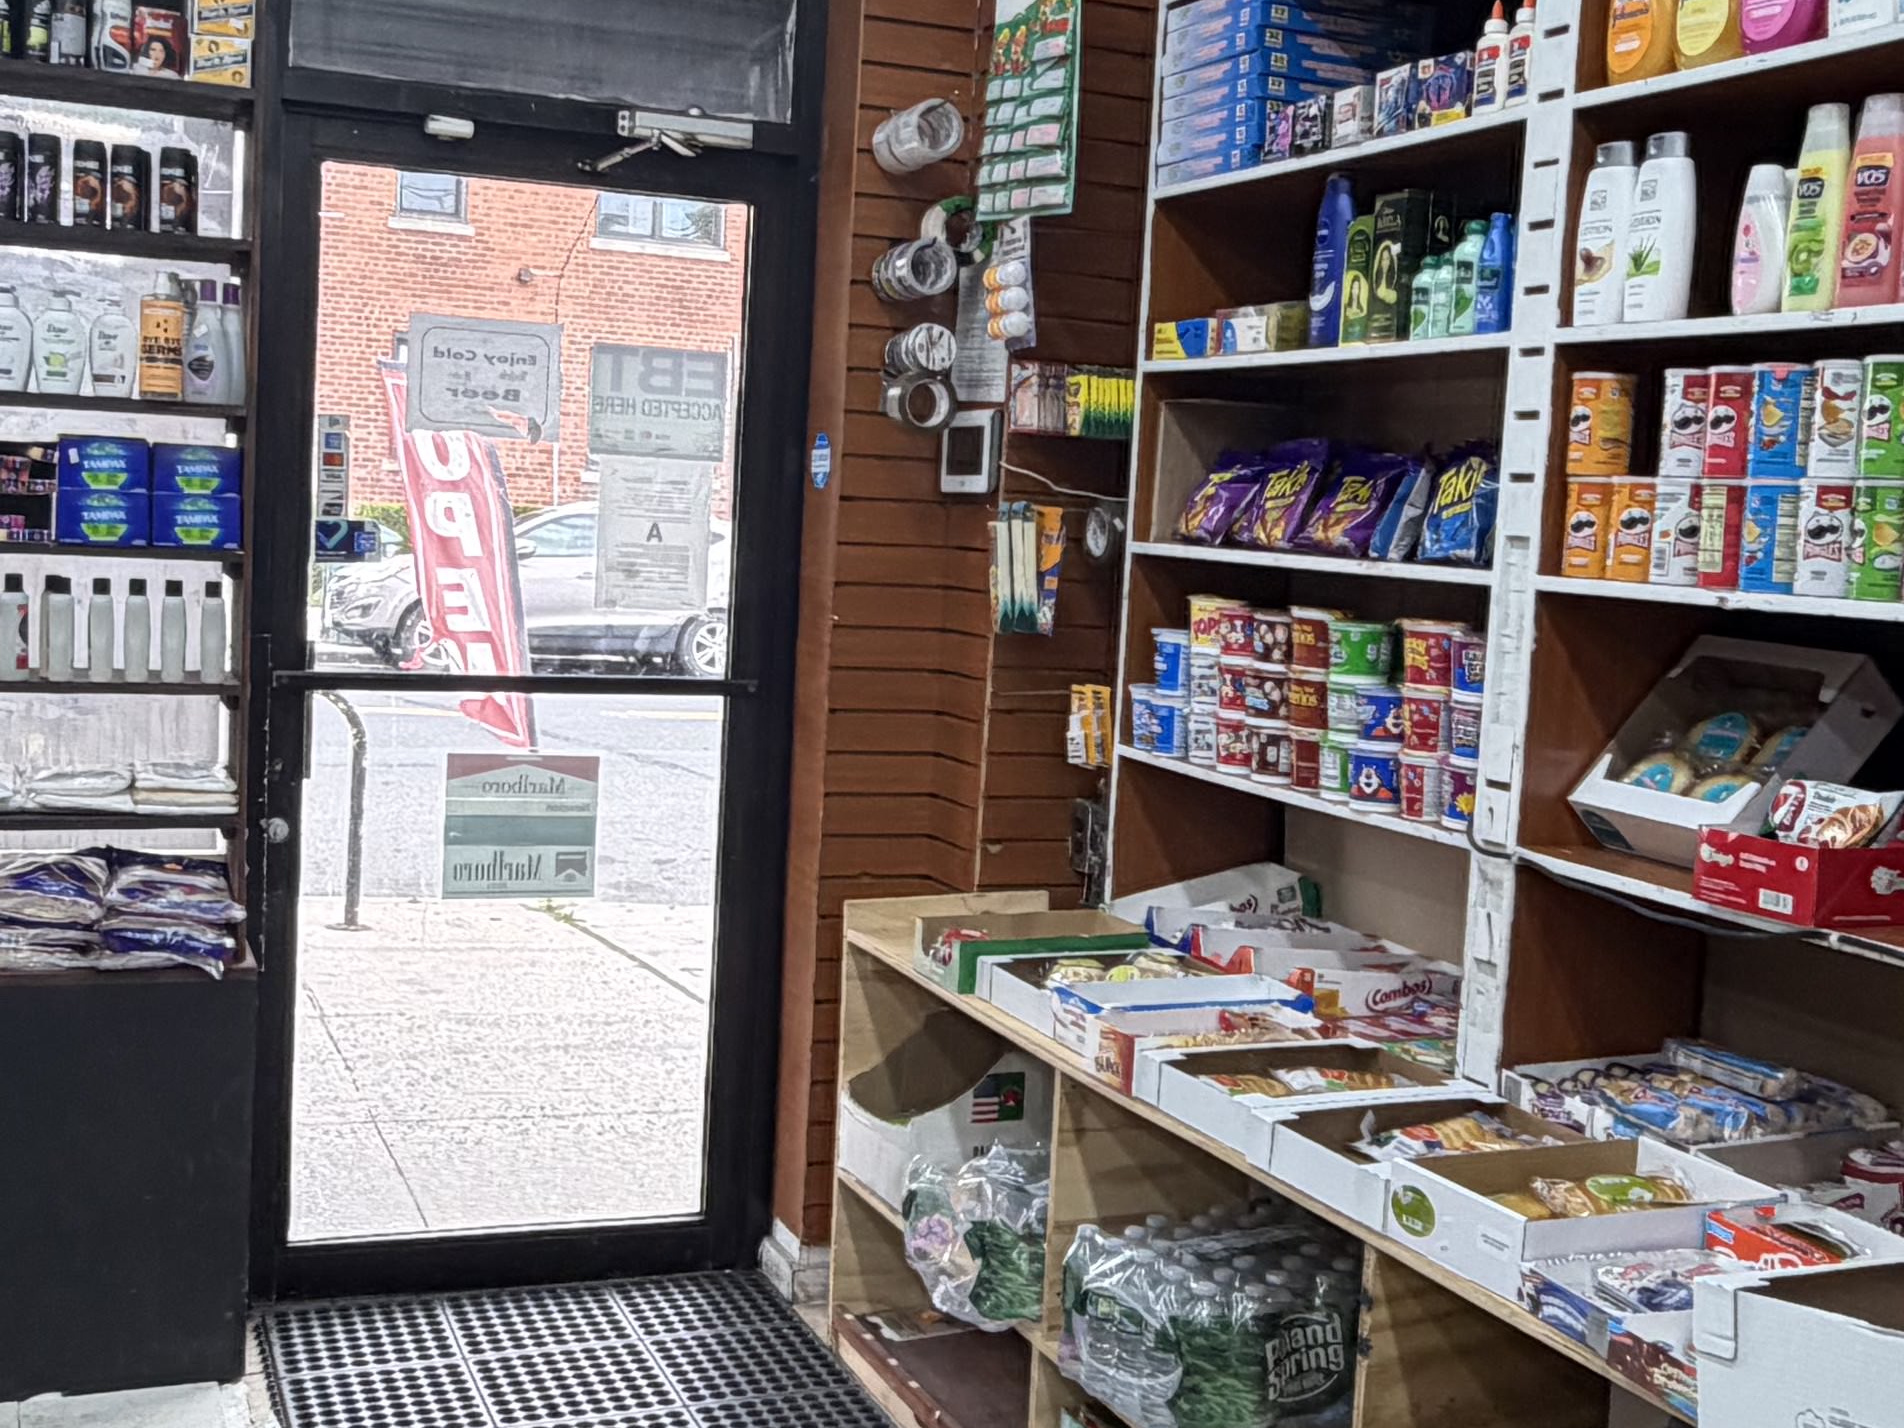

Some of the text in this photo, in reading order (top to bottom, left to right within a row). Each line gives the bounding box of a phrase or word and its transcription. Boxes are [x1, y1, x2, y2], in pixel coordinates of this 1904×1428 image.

[82, 459, 129, 474] TAMPAX
[177, 464, 220, 478] TAMPAX
[82, 510, 129, 525] TAMPAX
[176, 512, 220, 527] TAMPAX
[645, 521, 664, 543] A
